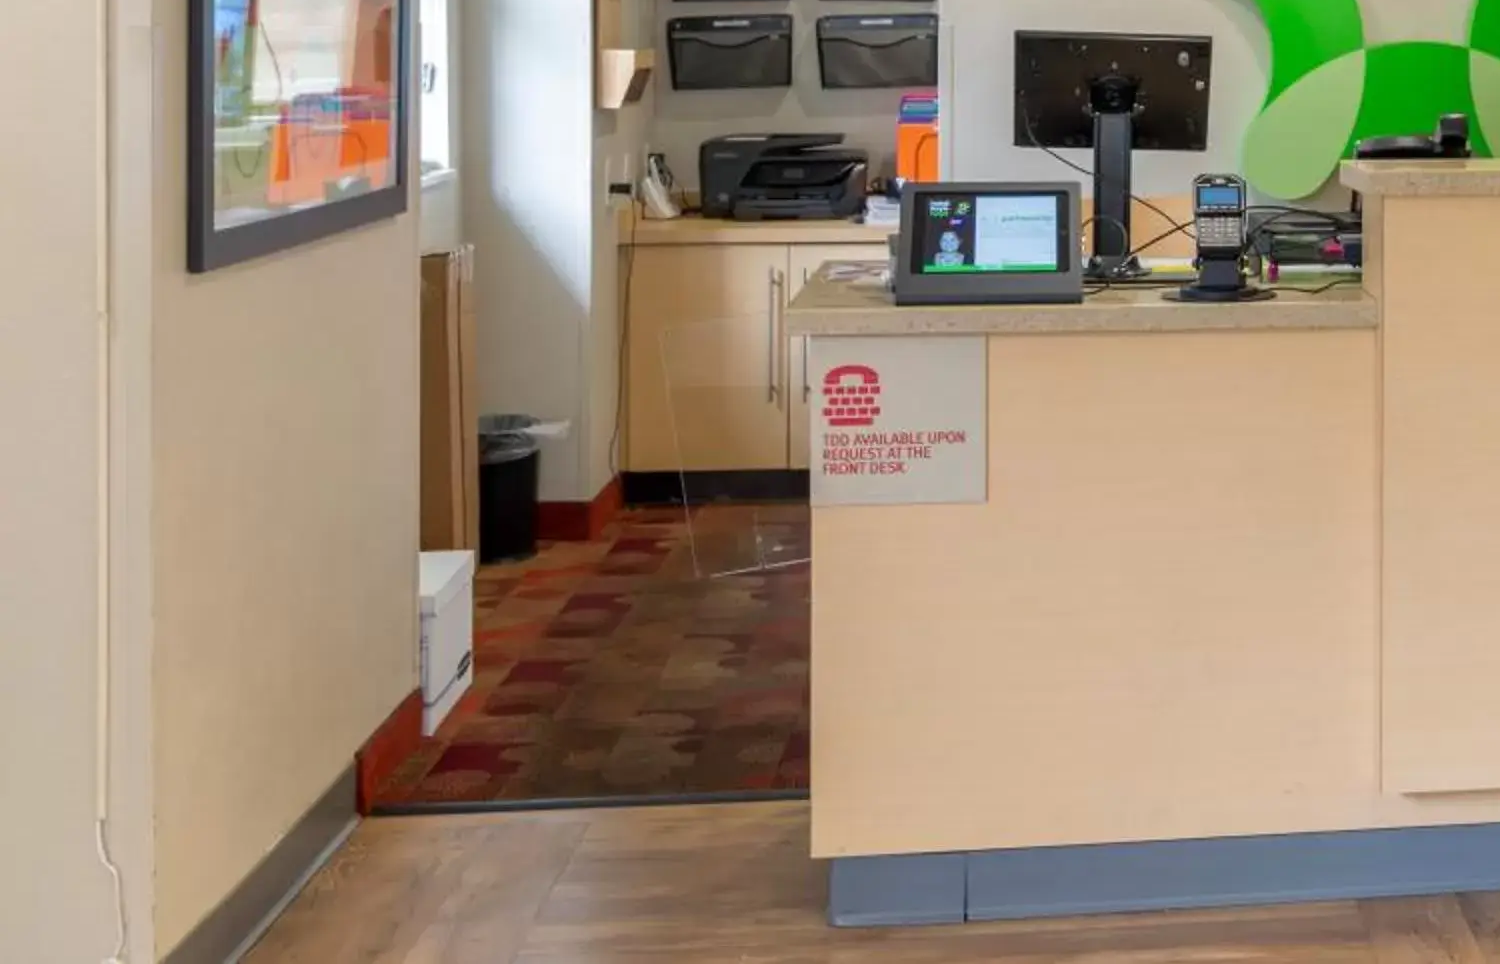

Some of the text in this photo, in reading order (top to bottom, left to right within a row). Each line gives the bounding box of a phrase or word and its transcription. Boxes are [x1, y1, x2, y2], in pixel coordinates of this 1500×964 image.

[824, 430, 966, 447] TDD AVAILABLE UPON
[822, 446, 932, 462] REQUEST AT THE
[822, 460, 905, 476] FRONT DESK
